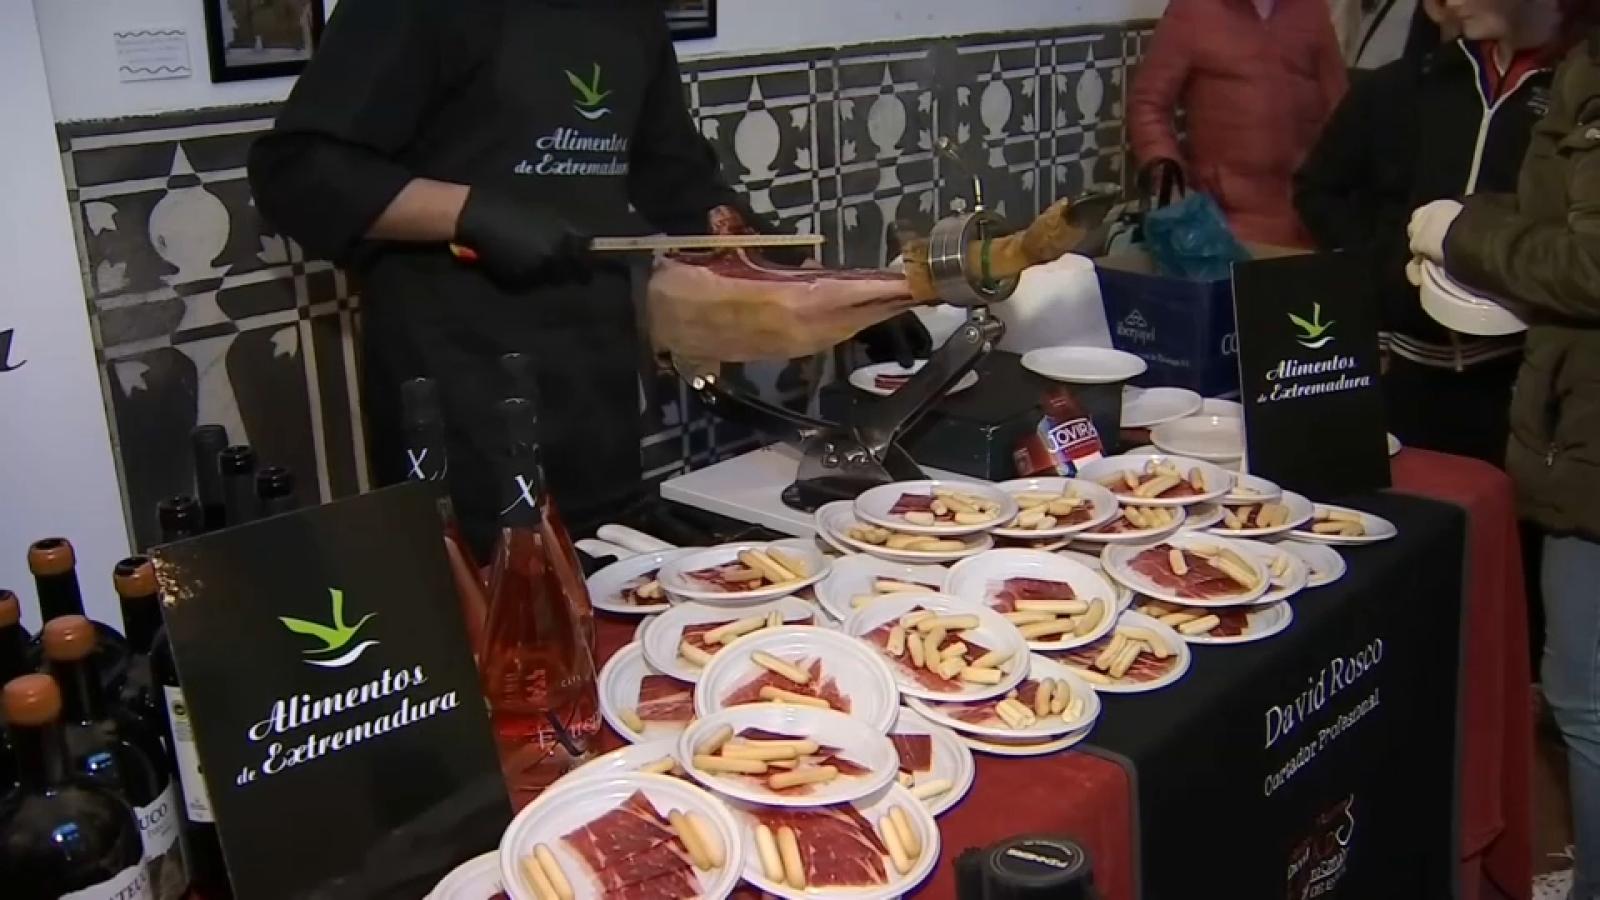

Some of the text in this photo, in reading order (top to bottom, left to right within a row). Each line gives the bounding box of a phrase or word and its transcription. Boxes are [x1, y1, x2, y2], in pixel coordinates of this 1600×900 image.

[1265, 355, 1356, 380] Alimentos
[1269, 373, 1370, 401] Extremadura
[248, 665, 427, 741] Alimentos
[1264, 637, 1383, 749] David Rosco
[236, 690, 460, 786] de Extremadura
